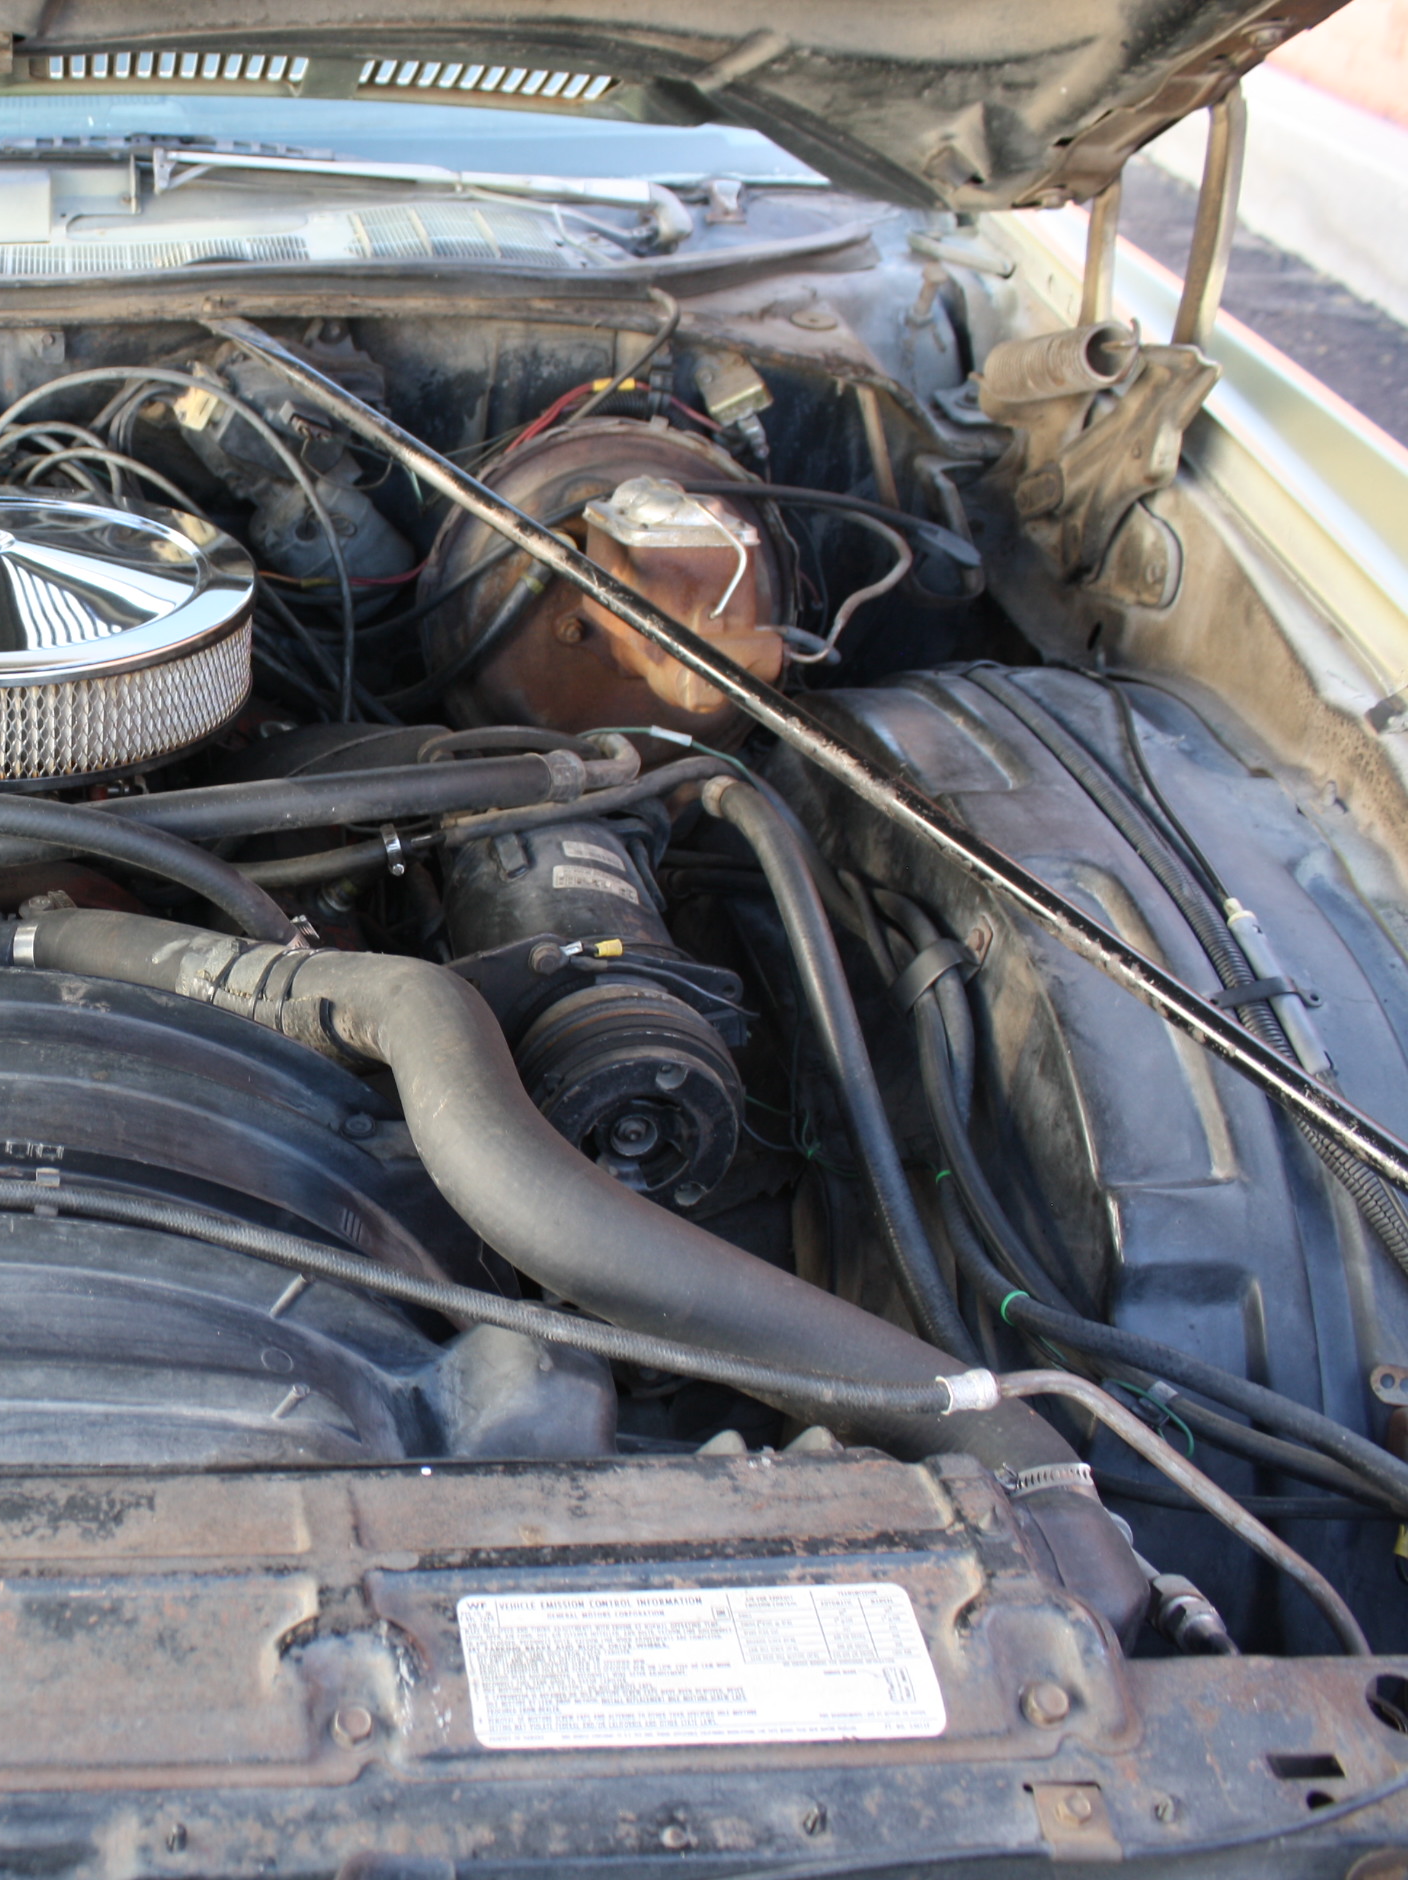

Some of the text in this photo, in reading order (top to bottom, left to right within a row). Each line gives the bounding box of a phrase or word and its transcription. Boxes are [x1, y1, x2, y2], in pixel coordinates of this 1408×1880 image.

[498, 1597, 702, 1611] VEHICLE EMISSION CONTROL INFORMATION
